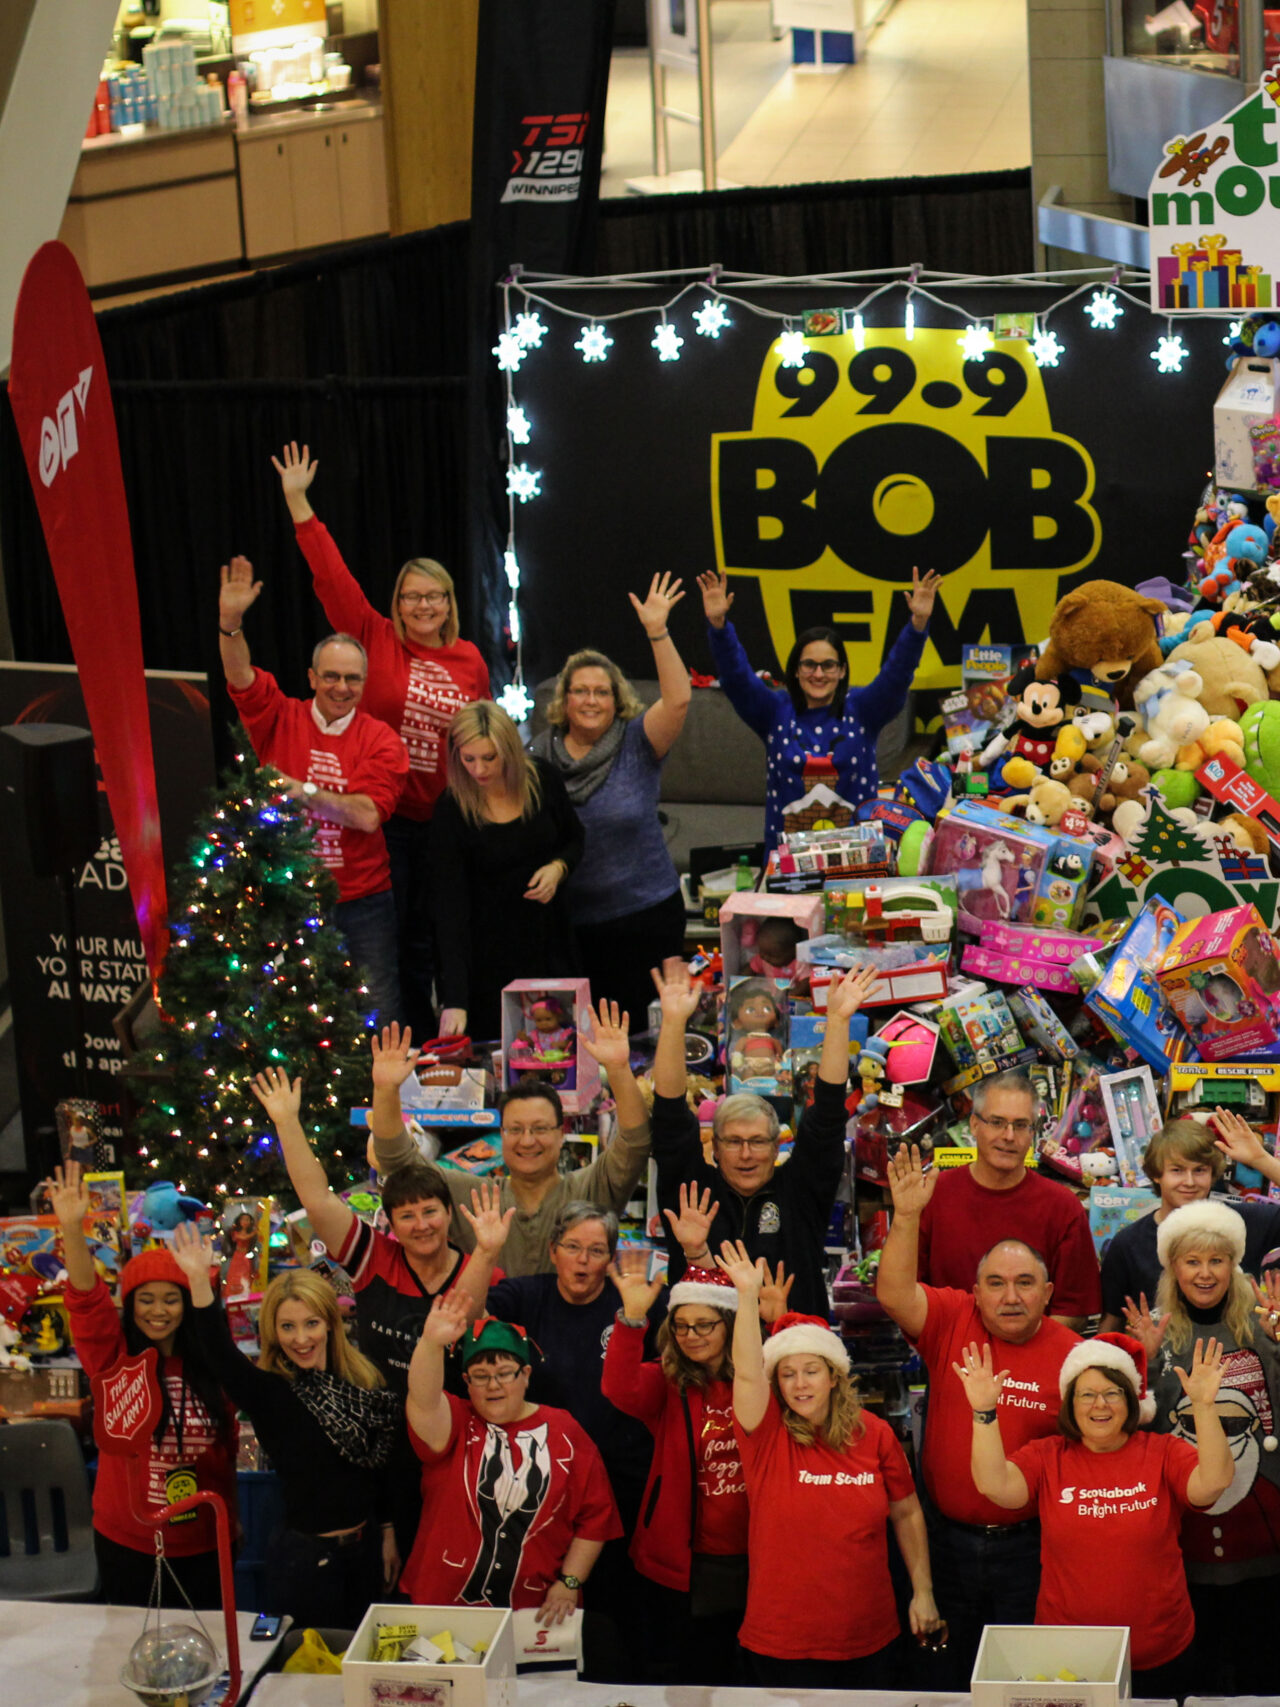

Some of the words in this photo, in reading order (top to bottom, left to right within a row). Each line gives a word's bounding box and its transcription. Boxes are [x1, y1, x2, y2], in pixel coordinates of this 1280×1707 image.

[774, 346, 1028, 418] 99.9
[39, 365, 94, 488] CTV
[719, 422, 1096, 583] BOB
[969, 647, 1002, 661] Little
[966, 659, 1007, 673] People
[1174, 1066, 1208, 1075] Tonka
[1094, 1196, 1131, 1206] DORY
[371, 1320, 411, 1341] GARTH
[109, 1373, 129, 1402] THE
[105, 1369, 146, 1431] SALVATION
[1006, 1394, 1047, 1412] Future
[122, 1391, 147, 1433] ARMY
[798, 1470, 832, 1485] Team
[834, 1472, 875, 1485] Scotia
[1079, 1482, 1147, 1499] Scotiabank
[1078, 1499, 1118, 1518] Bright
[1120, 1497, 1158, 1514] Future
